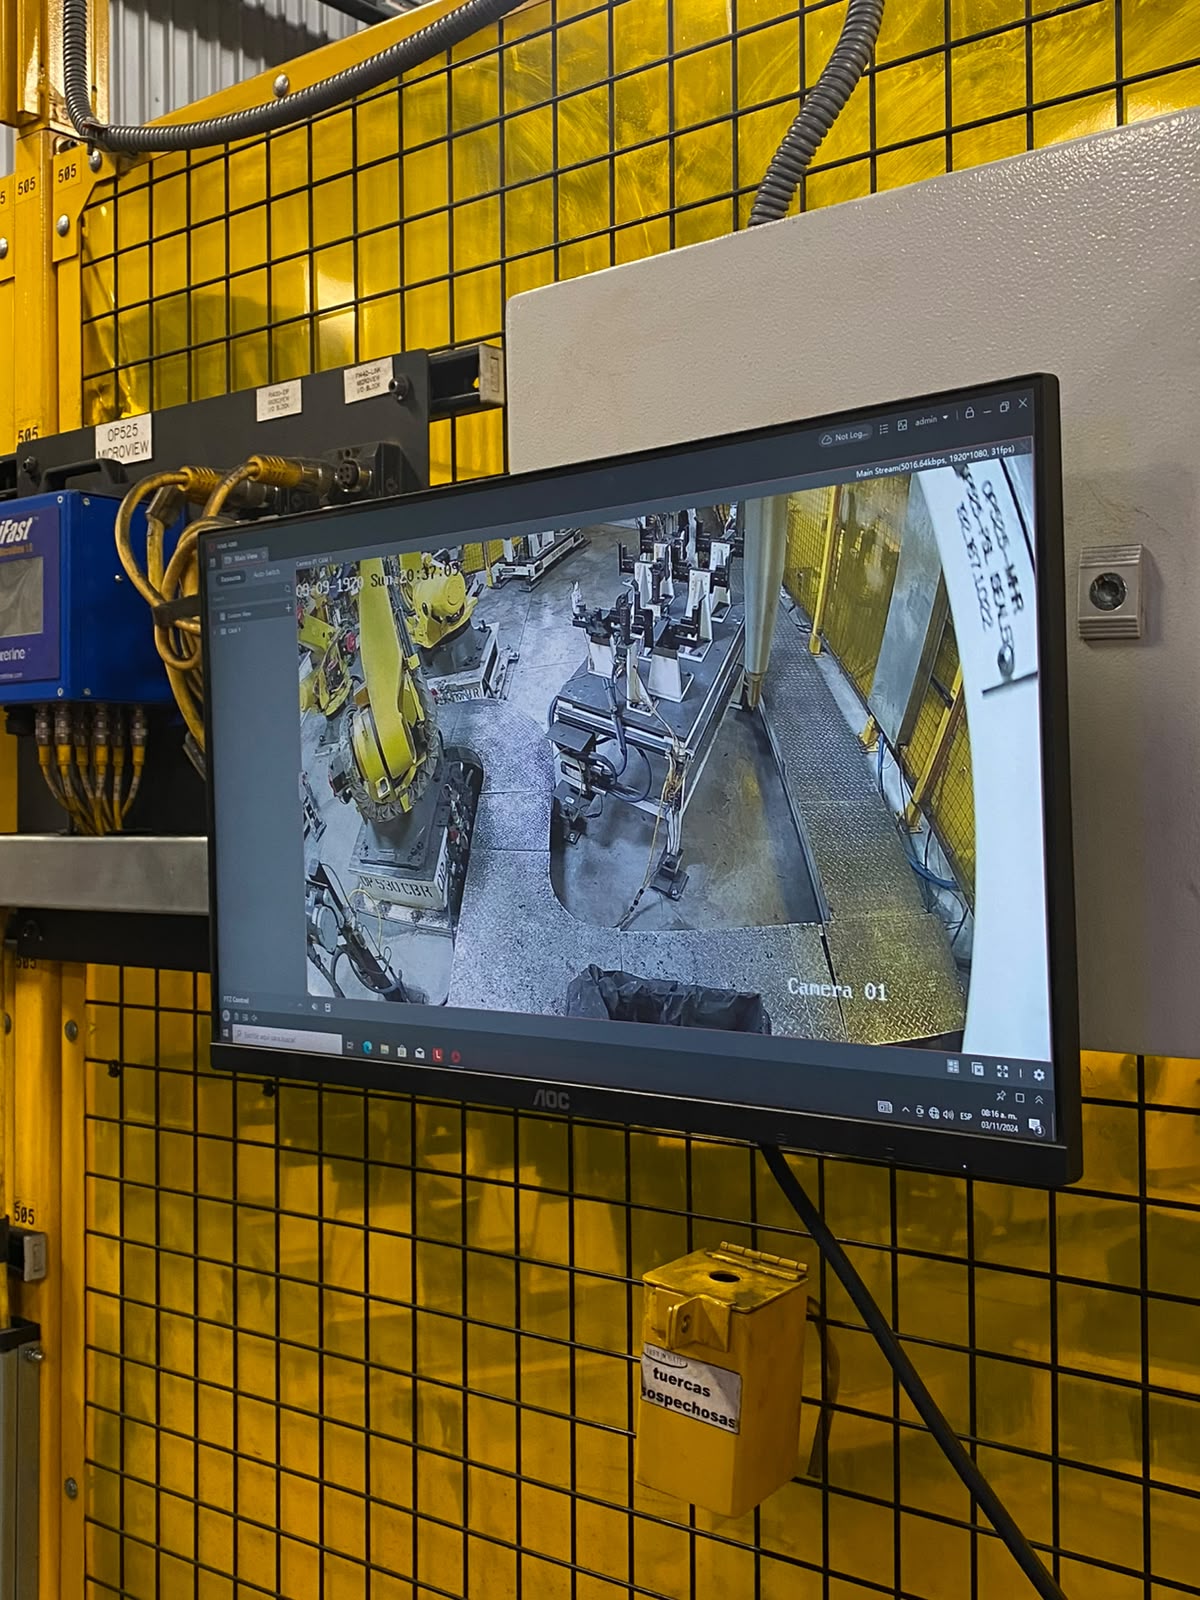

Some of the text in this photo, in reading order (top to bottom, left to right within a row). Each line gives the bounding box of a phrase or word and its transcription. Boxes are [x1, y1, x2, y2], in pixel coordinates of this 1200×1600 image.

[58, 163, 77, 183] 505
[17, 176, 36, 195] 505
[915, 415, 938, 426] admin
[18, 425, 39, 442] 505
[108, 423, 138, 442] OP525
[835, 432, 848, 441] Not
[98, 440, 149, 460] MICROVIEW
[856, 468, 874, 478] Main
[991, 445, 1015, 456] 31fps)
[370, 574, 392, 588] Sun
[400, 882, 434, 898] CBR
[788, 978, 888, 1001] Camera 01
[533, 1088, 570, 1110] AOC
[960, 1112, 972, 1121] ESP
[981, 1108, 999, 1118] 08:16
[980, 1121, 1019, 1133] 03/11/2024
[14, 1205, 35, 1226] 505
[653, 1367, 711, 1398] tuercas
